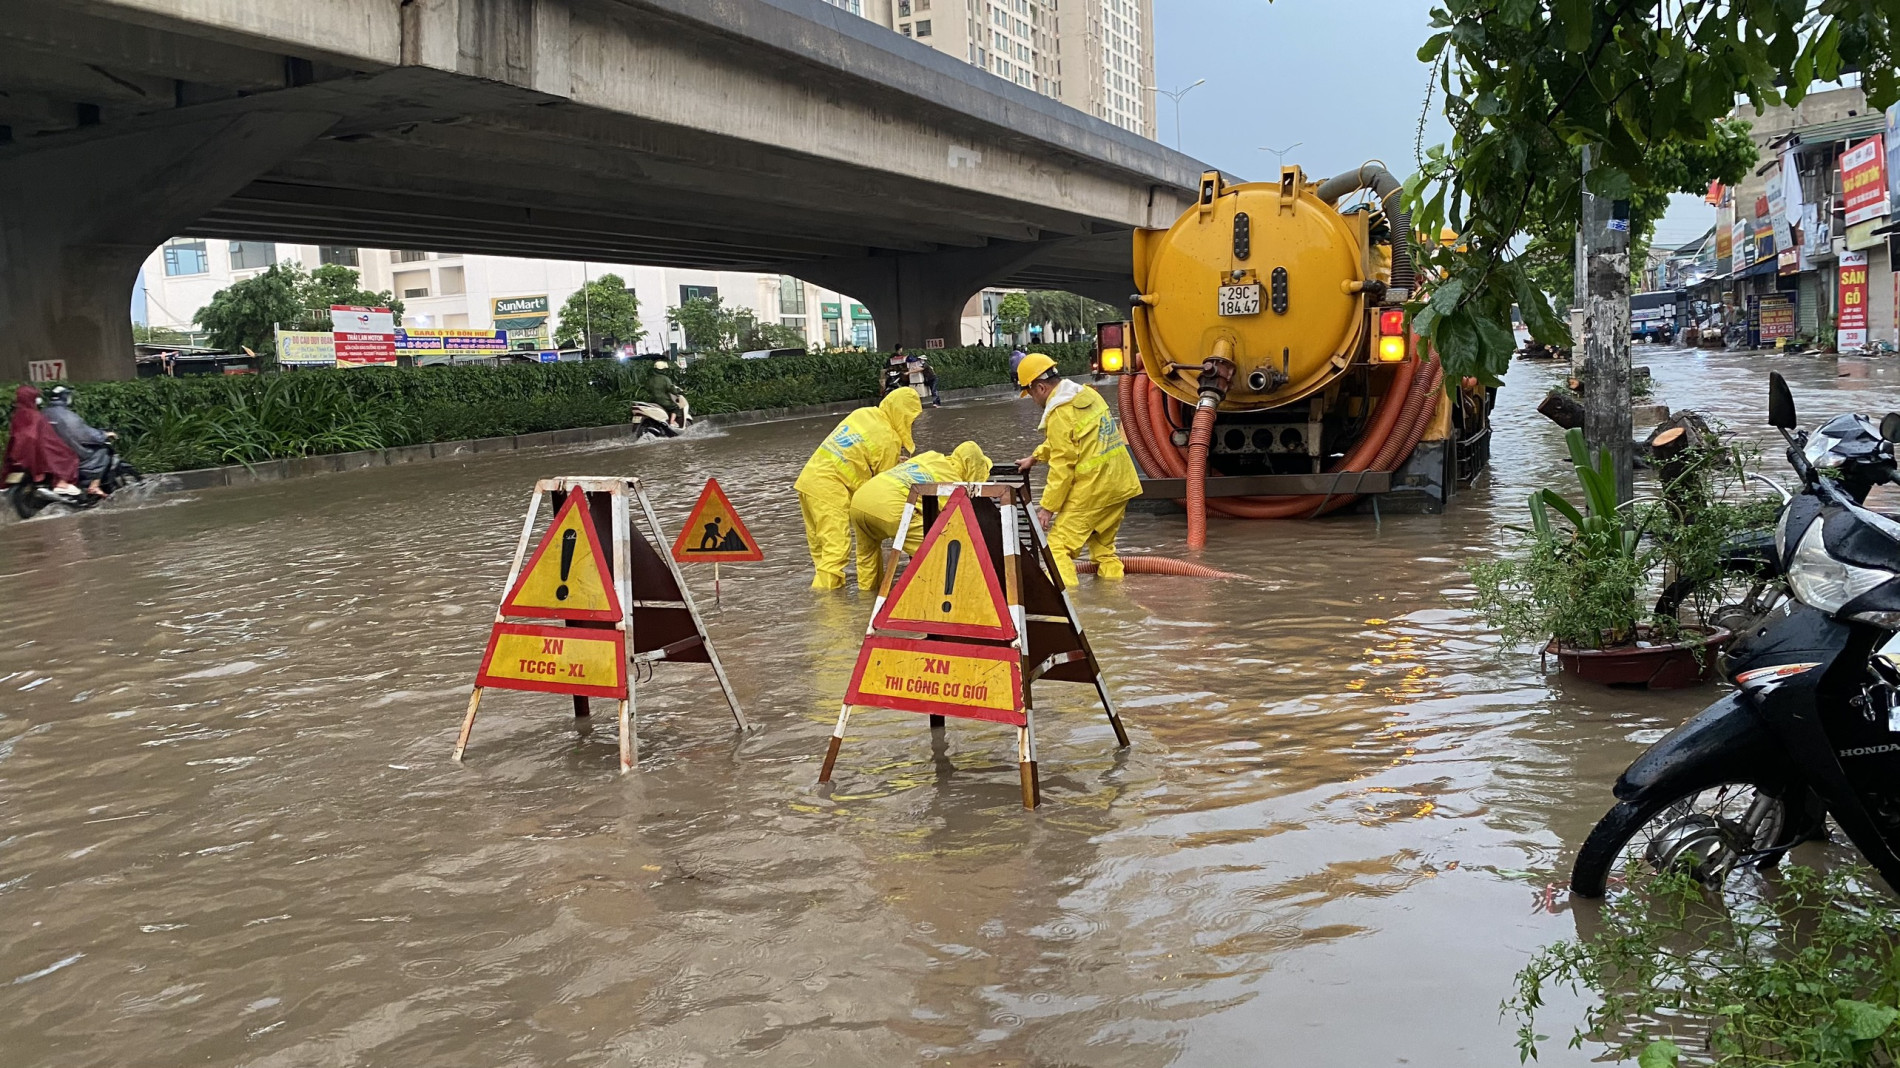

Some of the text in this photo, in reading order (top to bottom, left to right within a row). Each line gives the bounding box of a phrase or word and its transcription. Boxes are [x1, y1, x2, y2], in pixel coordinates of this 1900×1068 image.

[1841, 269, 1865, 284] SÀN
[1228, 286, 1250, 300] 29C
[1845, 286, 1861, 305] GỖ
[497, 298, 541, 312] SunMart
[1221, 299, 1259, 315] 184.47
[31, 362, 63, 381] T147
[541, 638, 564, 655] XN
[519, 659, 556, 675] TCCG
[568, 663, 586, 677] XL
[923, 658, 950, 675] XN
[885, 674, 903, 691] THI
[906, 676, 939, 695] CÔNG
[943, 682, 961, 697] CƠ
[1840, 743, 1900, 757] HONDA
